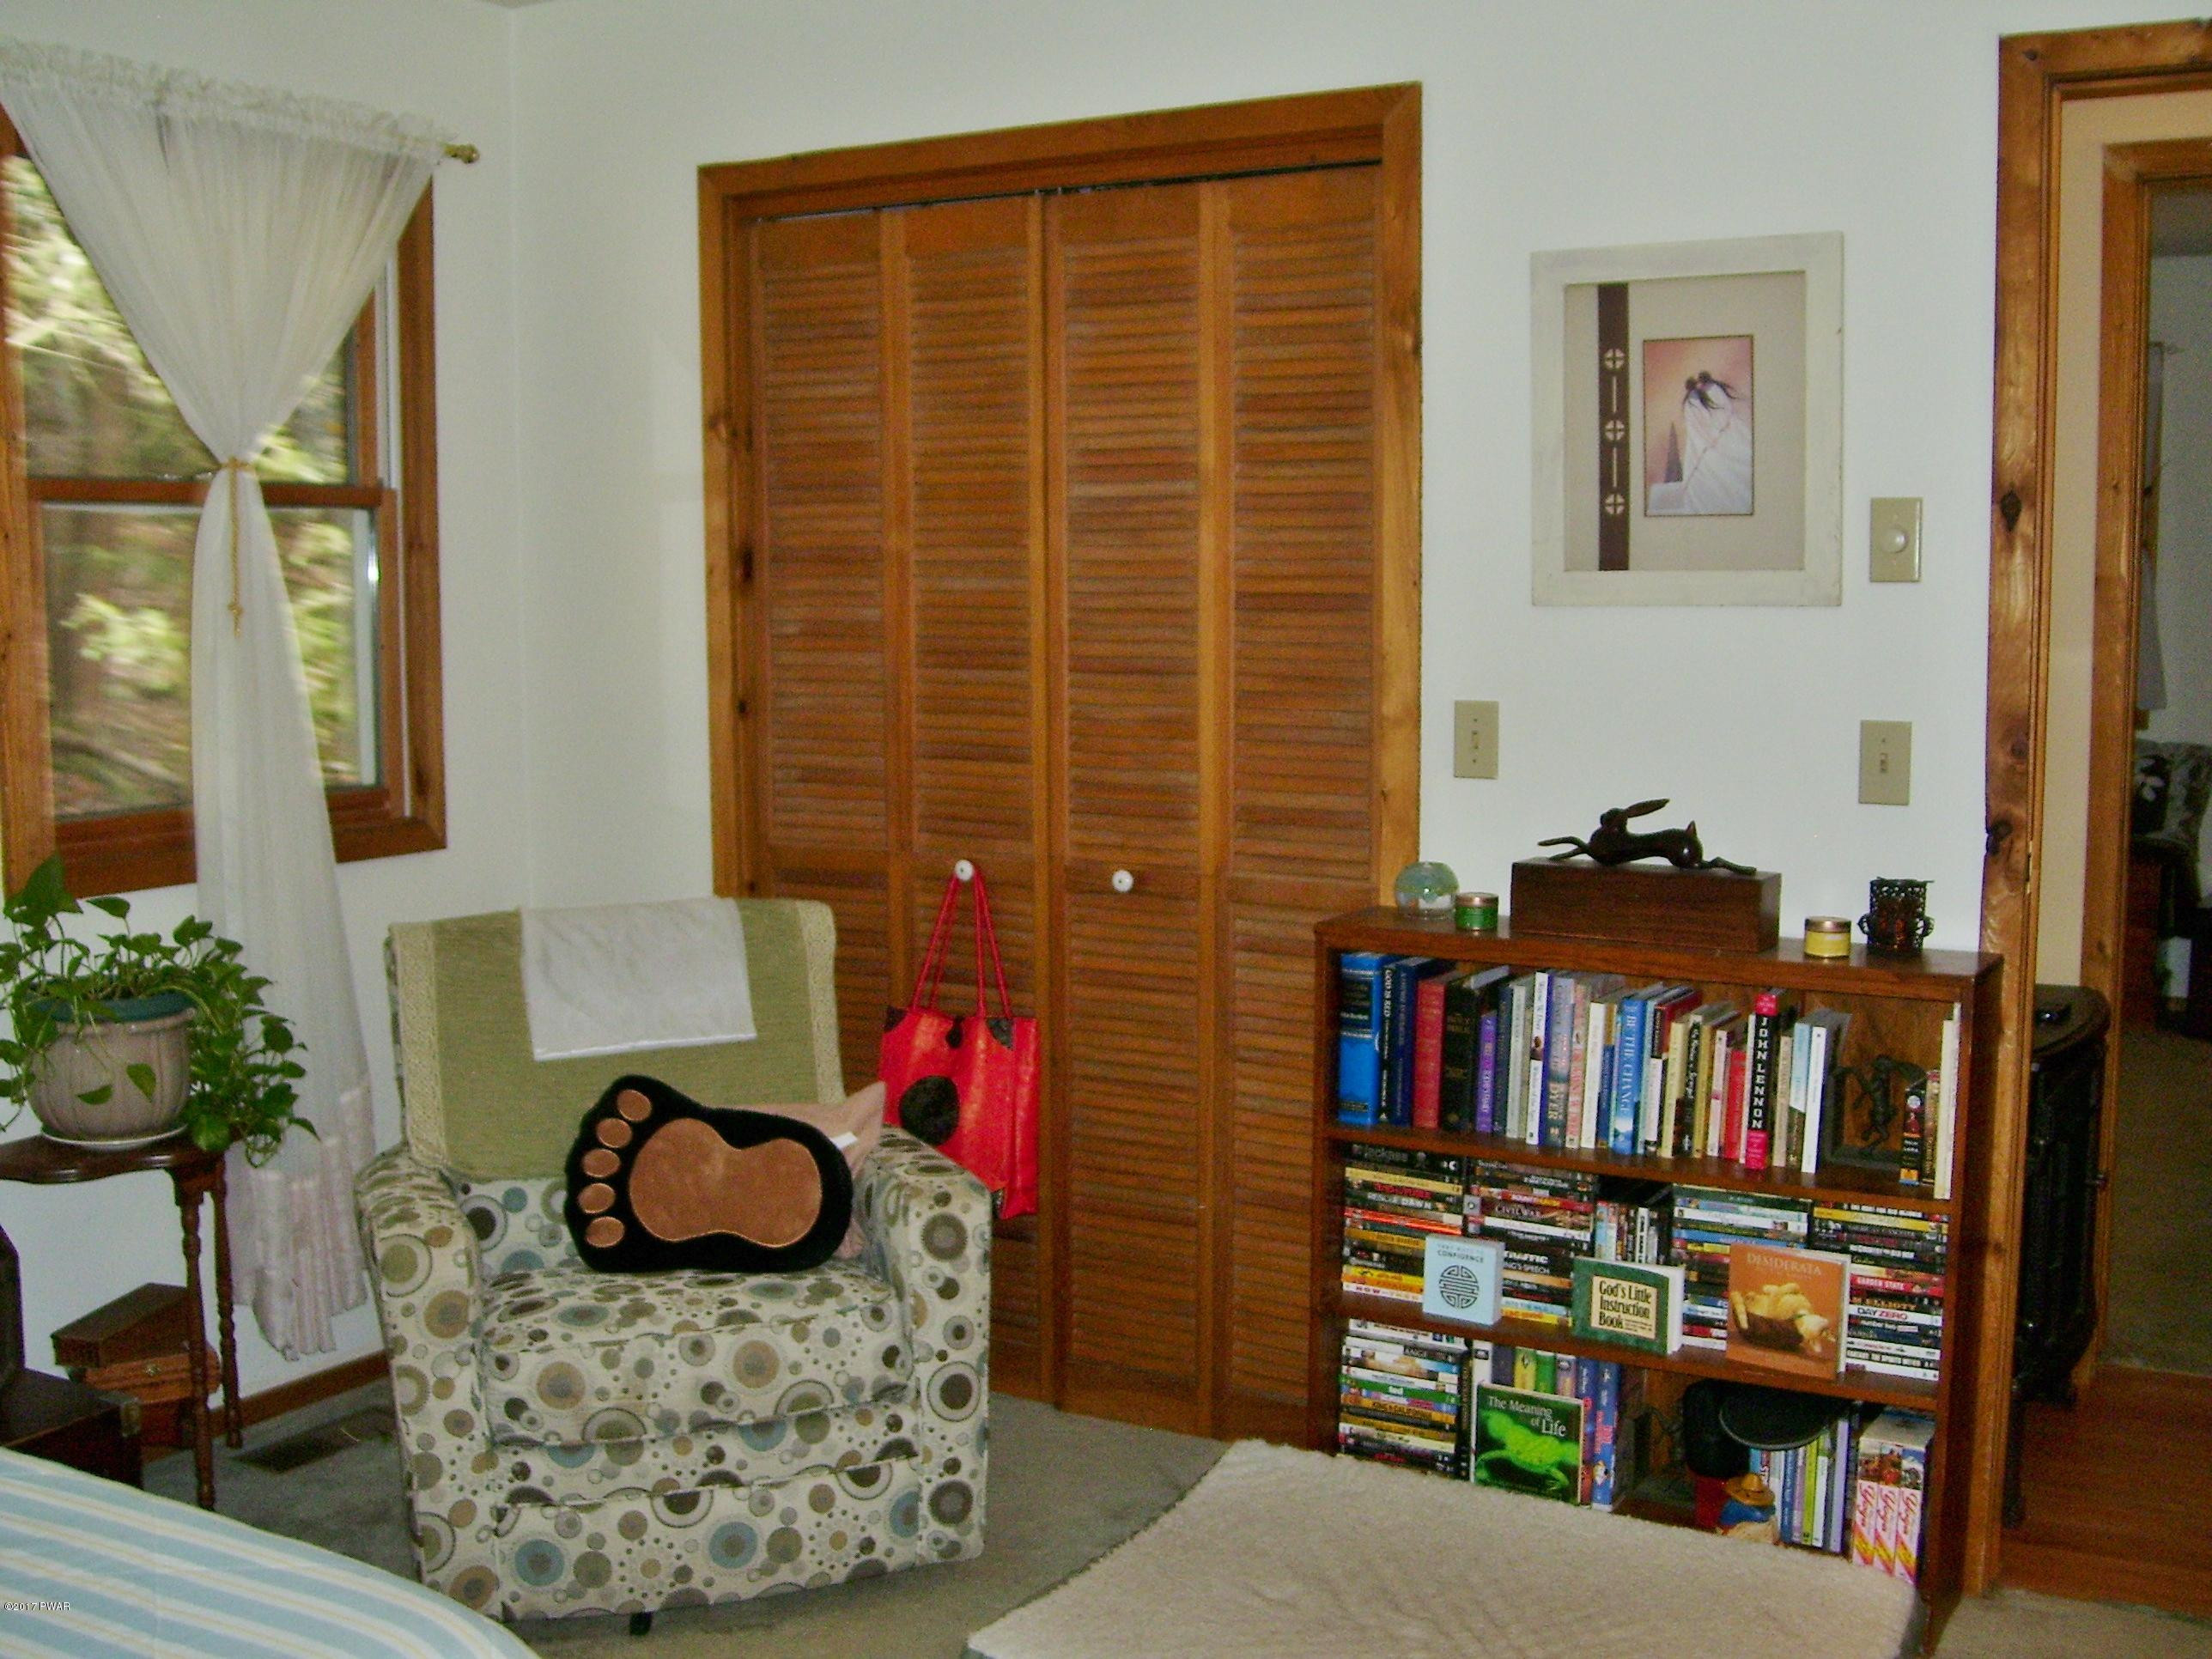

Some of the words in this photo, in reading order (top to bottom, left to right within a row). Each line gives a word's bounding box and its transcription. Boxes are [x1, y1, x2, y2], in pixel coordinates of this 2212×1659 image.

[1626, 1016, 1637, 1028] BE
[1623, 1036, 1636, 1060] THE
[1756, 1017, 1769, 1060] JOHN
[1620, 1063, 1634, 1112] CHANGE
[1751, 1064, 1767, 1129] LENNON
[1548, 1084, 1558, 1120] DYER
[1747, 1251, 1822, 1276] DESIDERATA
[1599, 1279, 1626, 1298] God's
[1628, 1284, 1652, 1304] Little
[1884, 1280, 1905, 1291] STATE
[1599, 1310, 1624, 1329] Book
[1600, 1295, 1650, 1320] Instruction
[1857, 1307, 1878, 1316] DAY
[1878, 1310, 1908, 1321] ZERO
[1488, 1396, 1507, 1409] The
[1510, 1400, 1553, 1420] Meaning
[1530, 1417, 1541, 1427] of
[1541, 1419, 1567, 1437] Life
